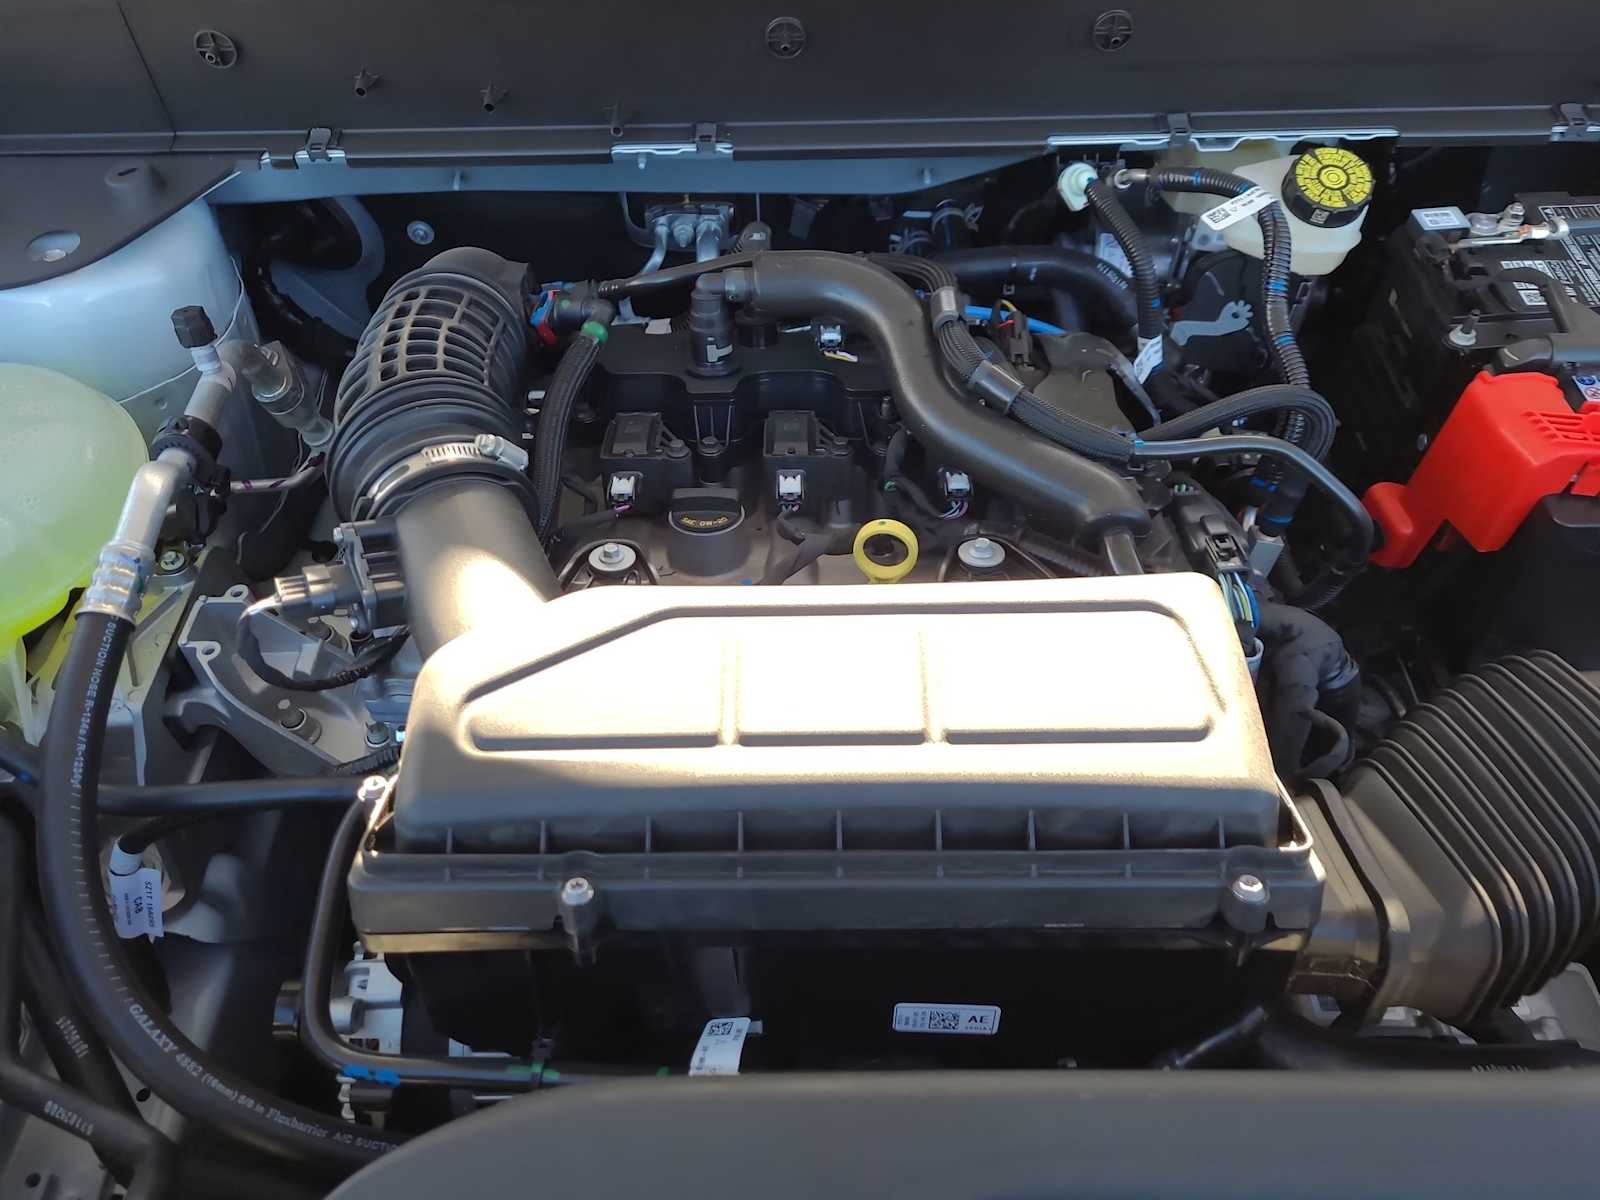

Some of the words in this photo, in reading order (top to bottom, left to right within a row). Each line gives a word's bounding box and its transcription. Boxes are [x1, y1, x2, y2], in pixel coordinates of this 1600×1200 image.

[95, 622, 117, 667] SUCTION
[87, 668, 104, 698] HOSE
[129, 1004, 178, 1053] GALAXY
[968, 1015, 992, 1024] AE
